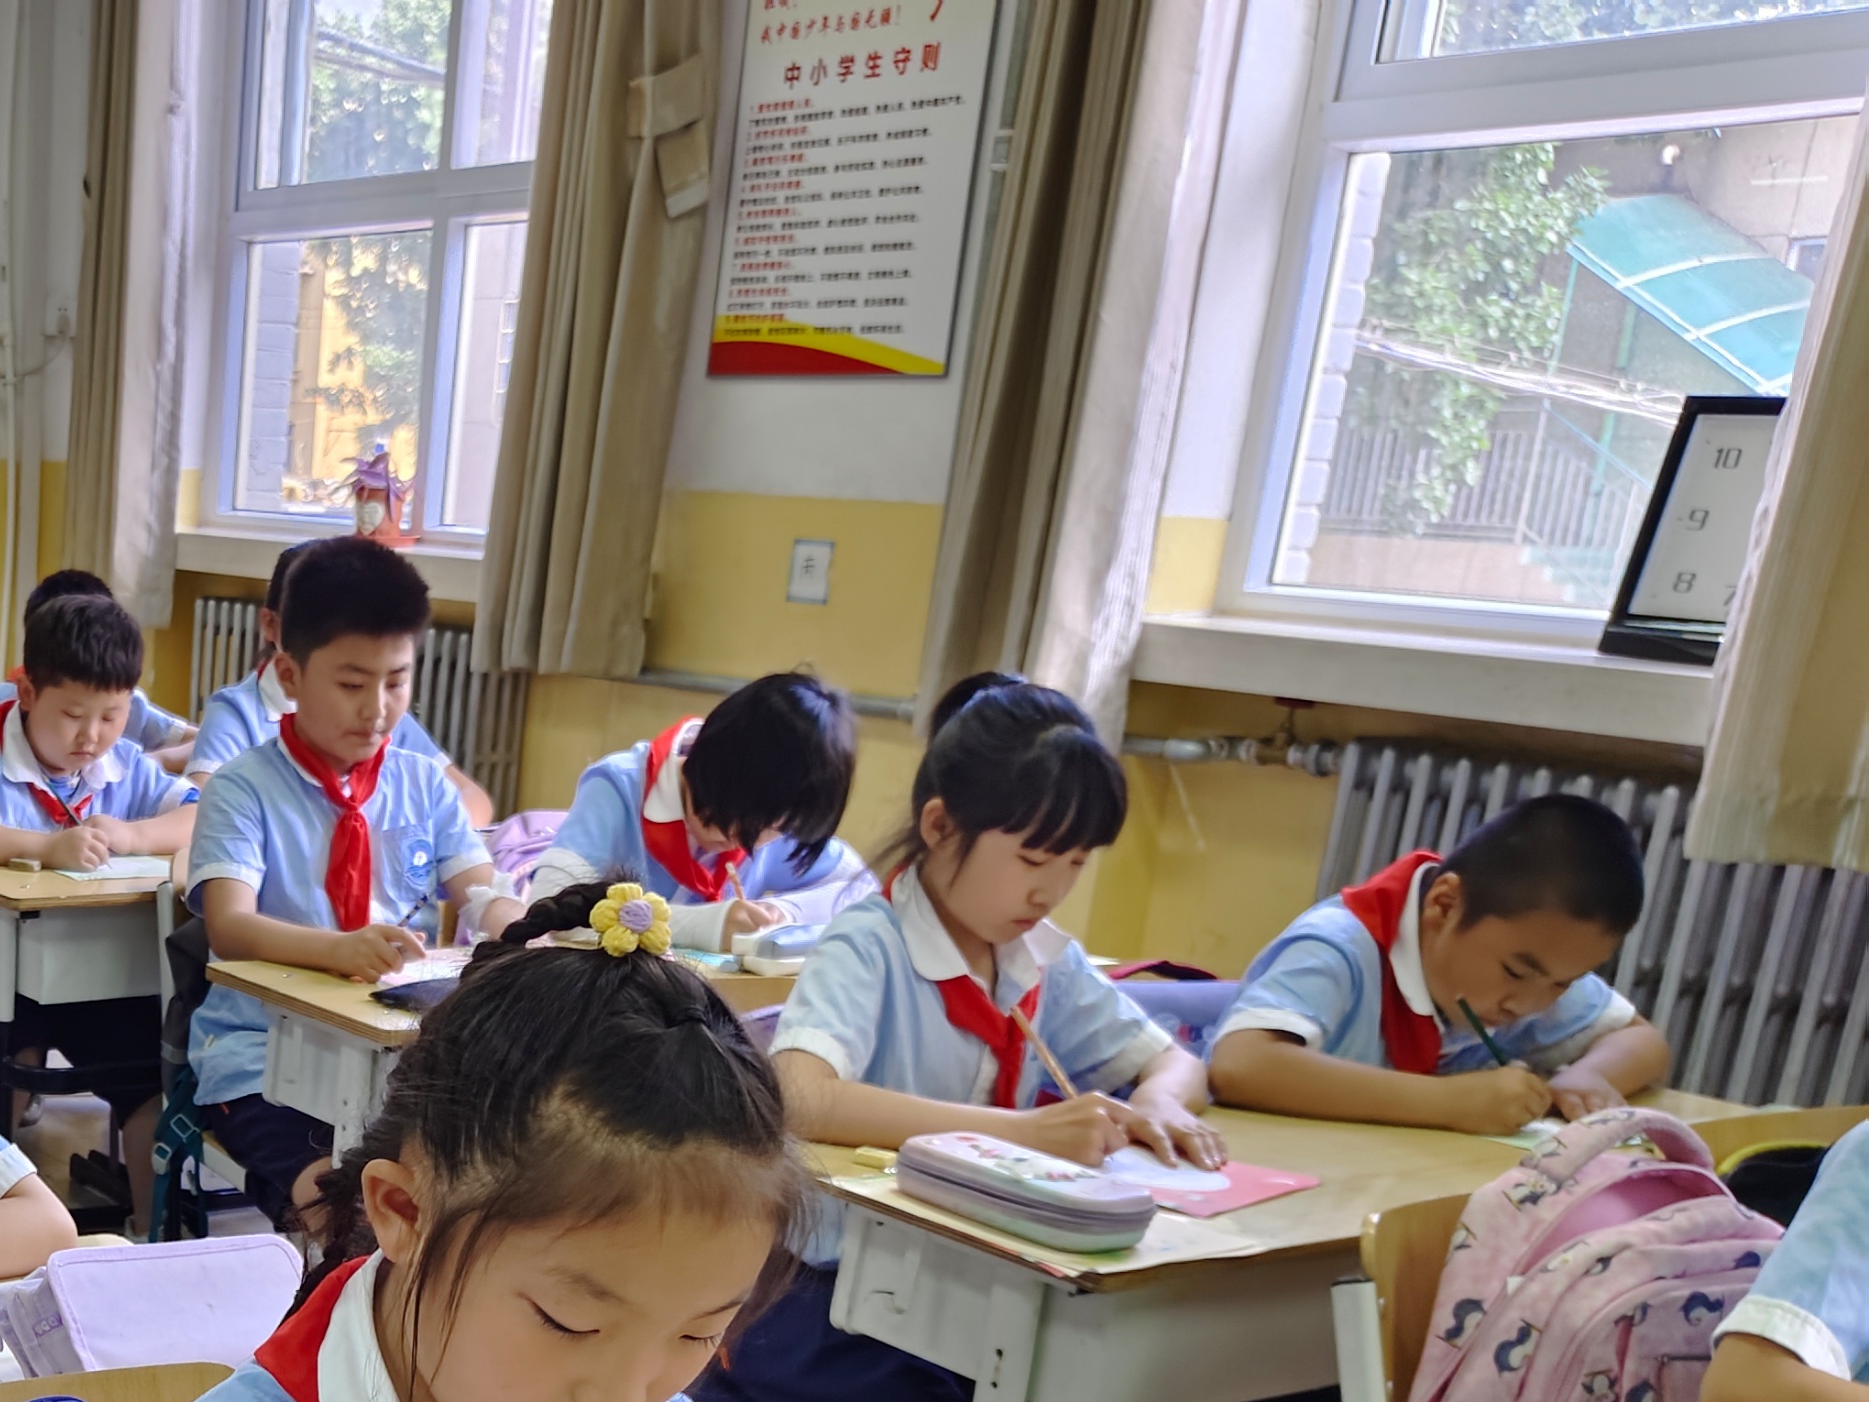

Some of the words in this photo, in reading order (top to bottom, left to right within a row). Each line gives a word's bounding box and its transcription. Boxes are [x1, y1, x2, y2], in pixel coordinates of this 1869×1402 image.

[783, 42, 942, 90] 中小学生守则
[1713, 447, 1742, 469] 10
[1685, 508, 1710, 531] 9
[1672, 571, 1697, 594] 8
